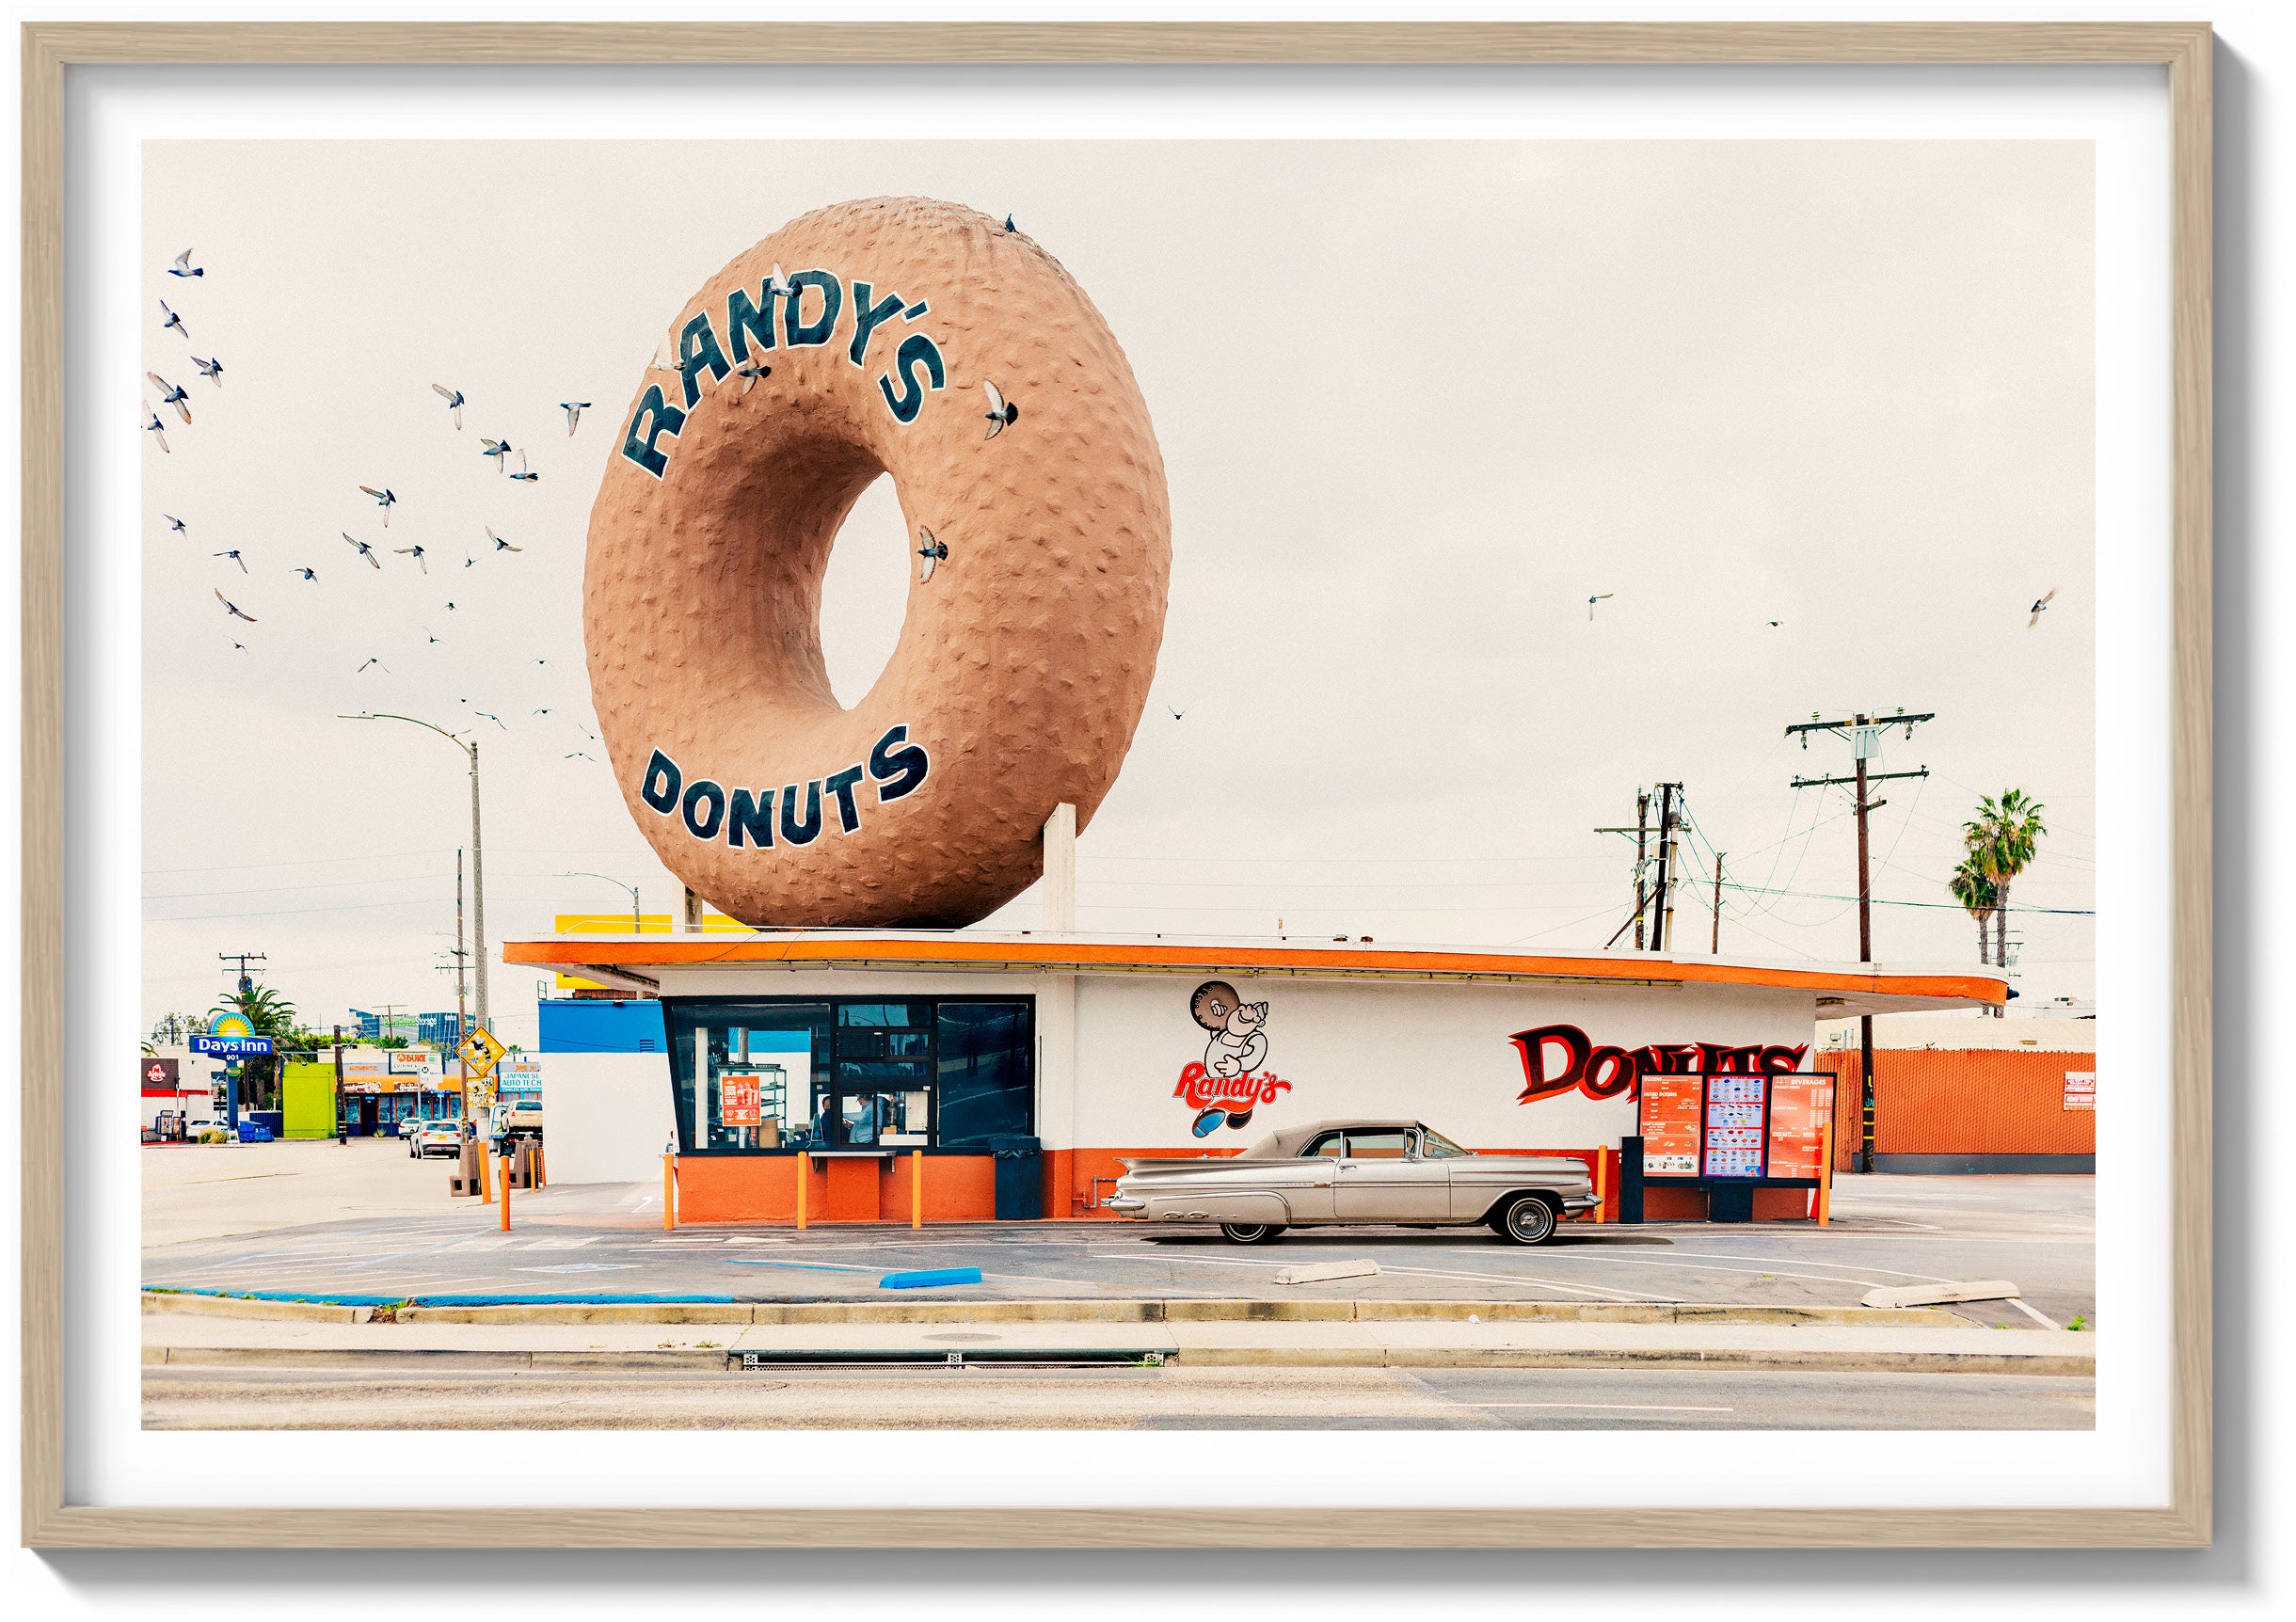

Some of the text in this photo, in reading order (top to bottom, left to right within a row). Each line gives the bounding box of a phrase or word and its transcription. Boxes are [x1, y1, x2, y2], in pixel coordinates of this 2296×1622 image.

[620, 267, 946, 482] RANDY'S
[641, 723, 930, 850] DONUTS
[199, 1039, 267, 1052] Days Inn
[1172, 1060, 1293, 1114] Randy's
